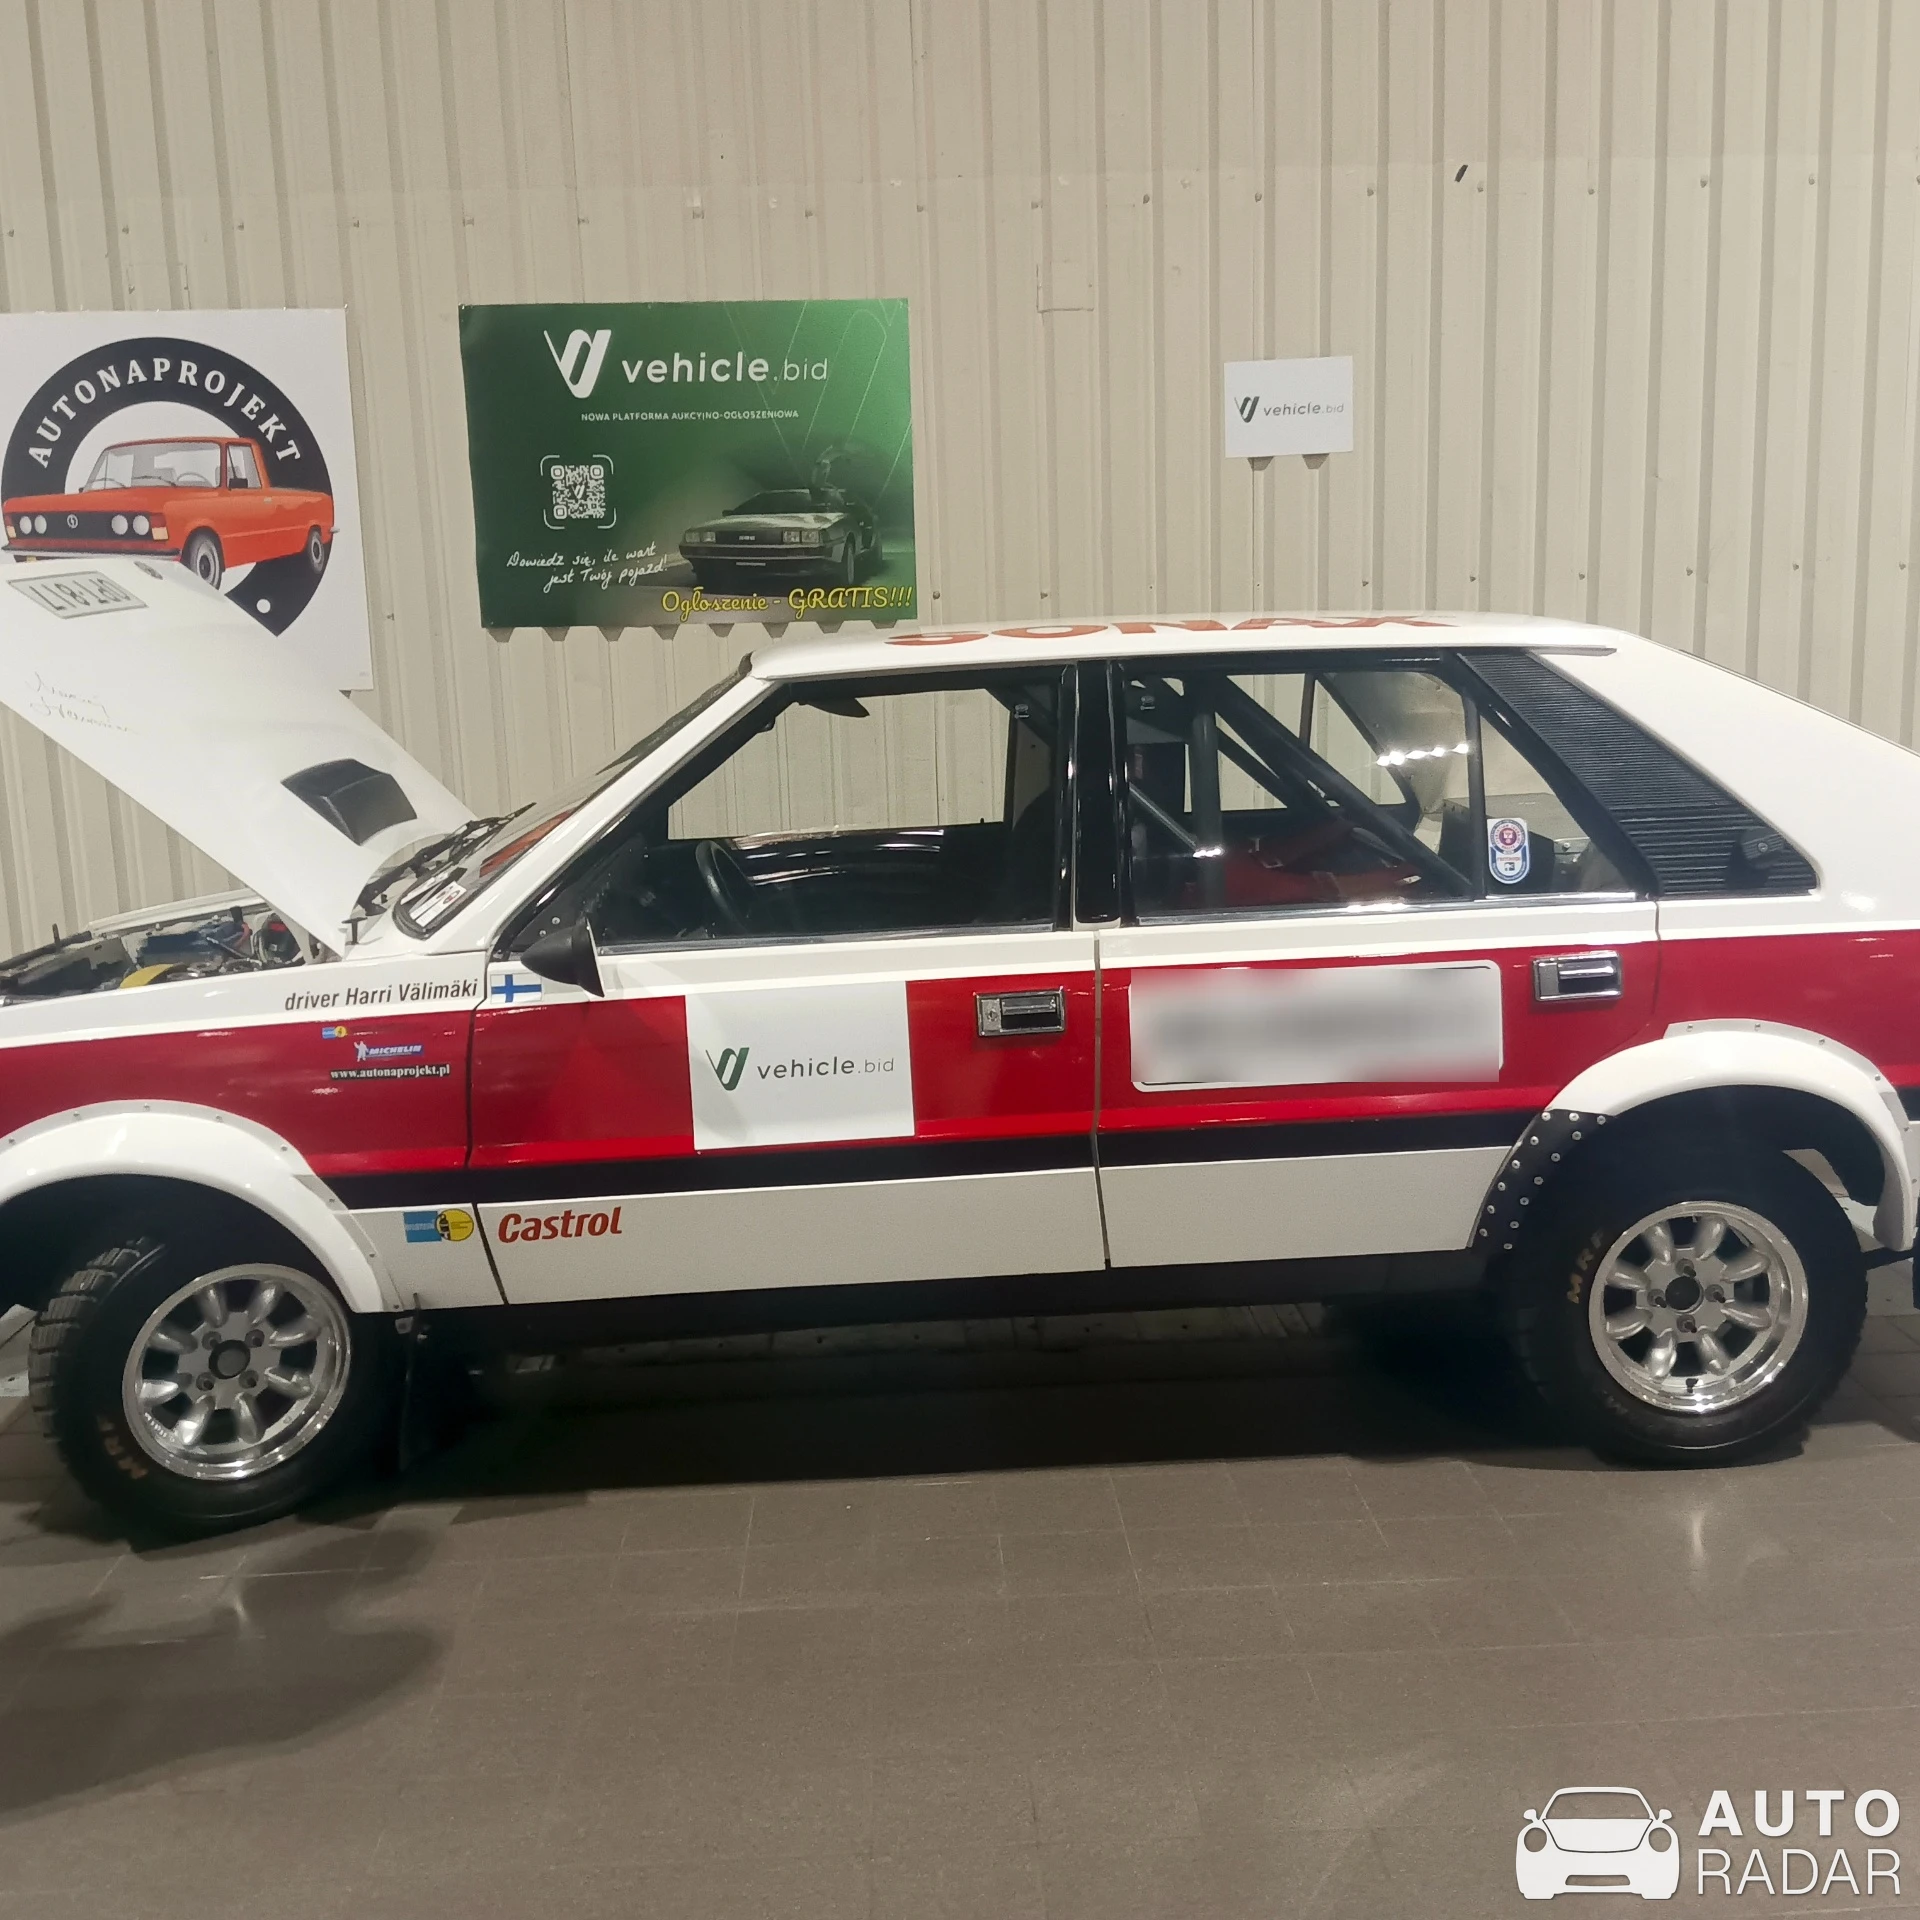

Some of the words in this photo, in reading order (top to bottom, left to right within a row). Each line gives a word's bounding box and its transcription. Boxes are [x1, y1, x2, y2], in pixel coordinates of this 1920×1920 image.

[622, 351, 828, 384] vehicle.bid
[28, 357, 300, 469] AUTONAPROJEKT
[581, 413, 611, 422] NOWA
[612, 411, 669, 421] PLATFORMA
[671, 409, 800, 421] AUKCYJNO-OGŁOSZENIOWA
[1263, 401, 1345, 416] vehicle.bid
[506, 551, 565, 567] Dowiedz
[603, 548, 619, 563] ile
[626, 541, 657, 560] wart
[543, 567, 574, 593] jest
[580, 563, 613, 590] Twój
[618, 554, 668, 587] pojazd!
[662, 586, 769, 622] Ogłoszenie
[787, 586, 914, 620] GRATIS!!!
[884, 615, 1460, 646] SONAX
[285, 990, 340, 1011] driver
[345, 985, 393, 1006] Harri
[399, 978, 479, 1002] Välimäki
[368, 1044, 422, 1056] MICHELIN
[330, 1063, 451, 1080] www.autonaprojekt.pl
[756, 1056, 895, 1080] vehicle.bid
[497, 1205, 623, 1244] Castrol
